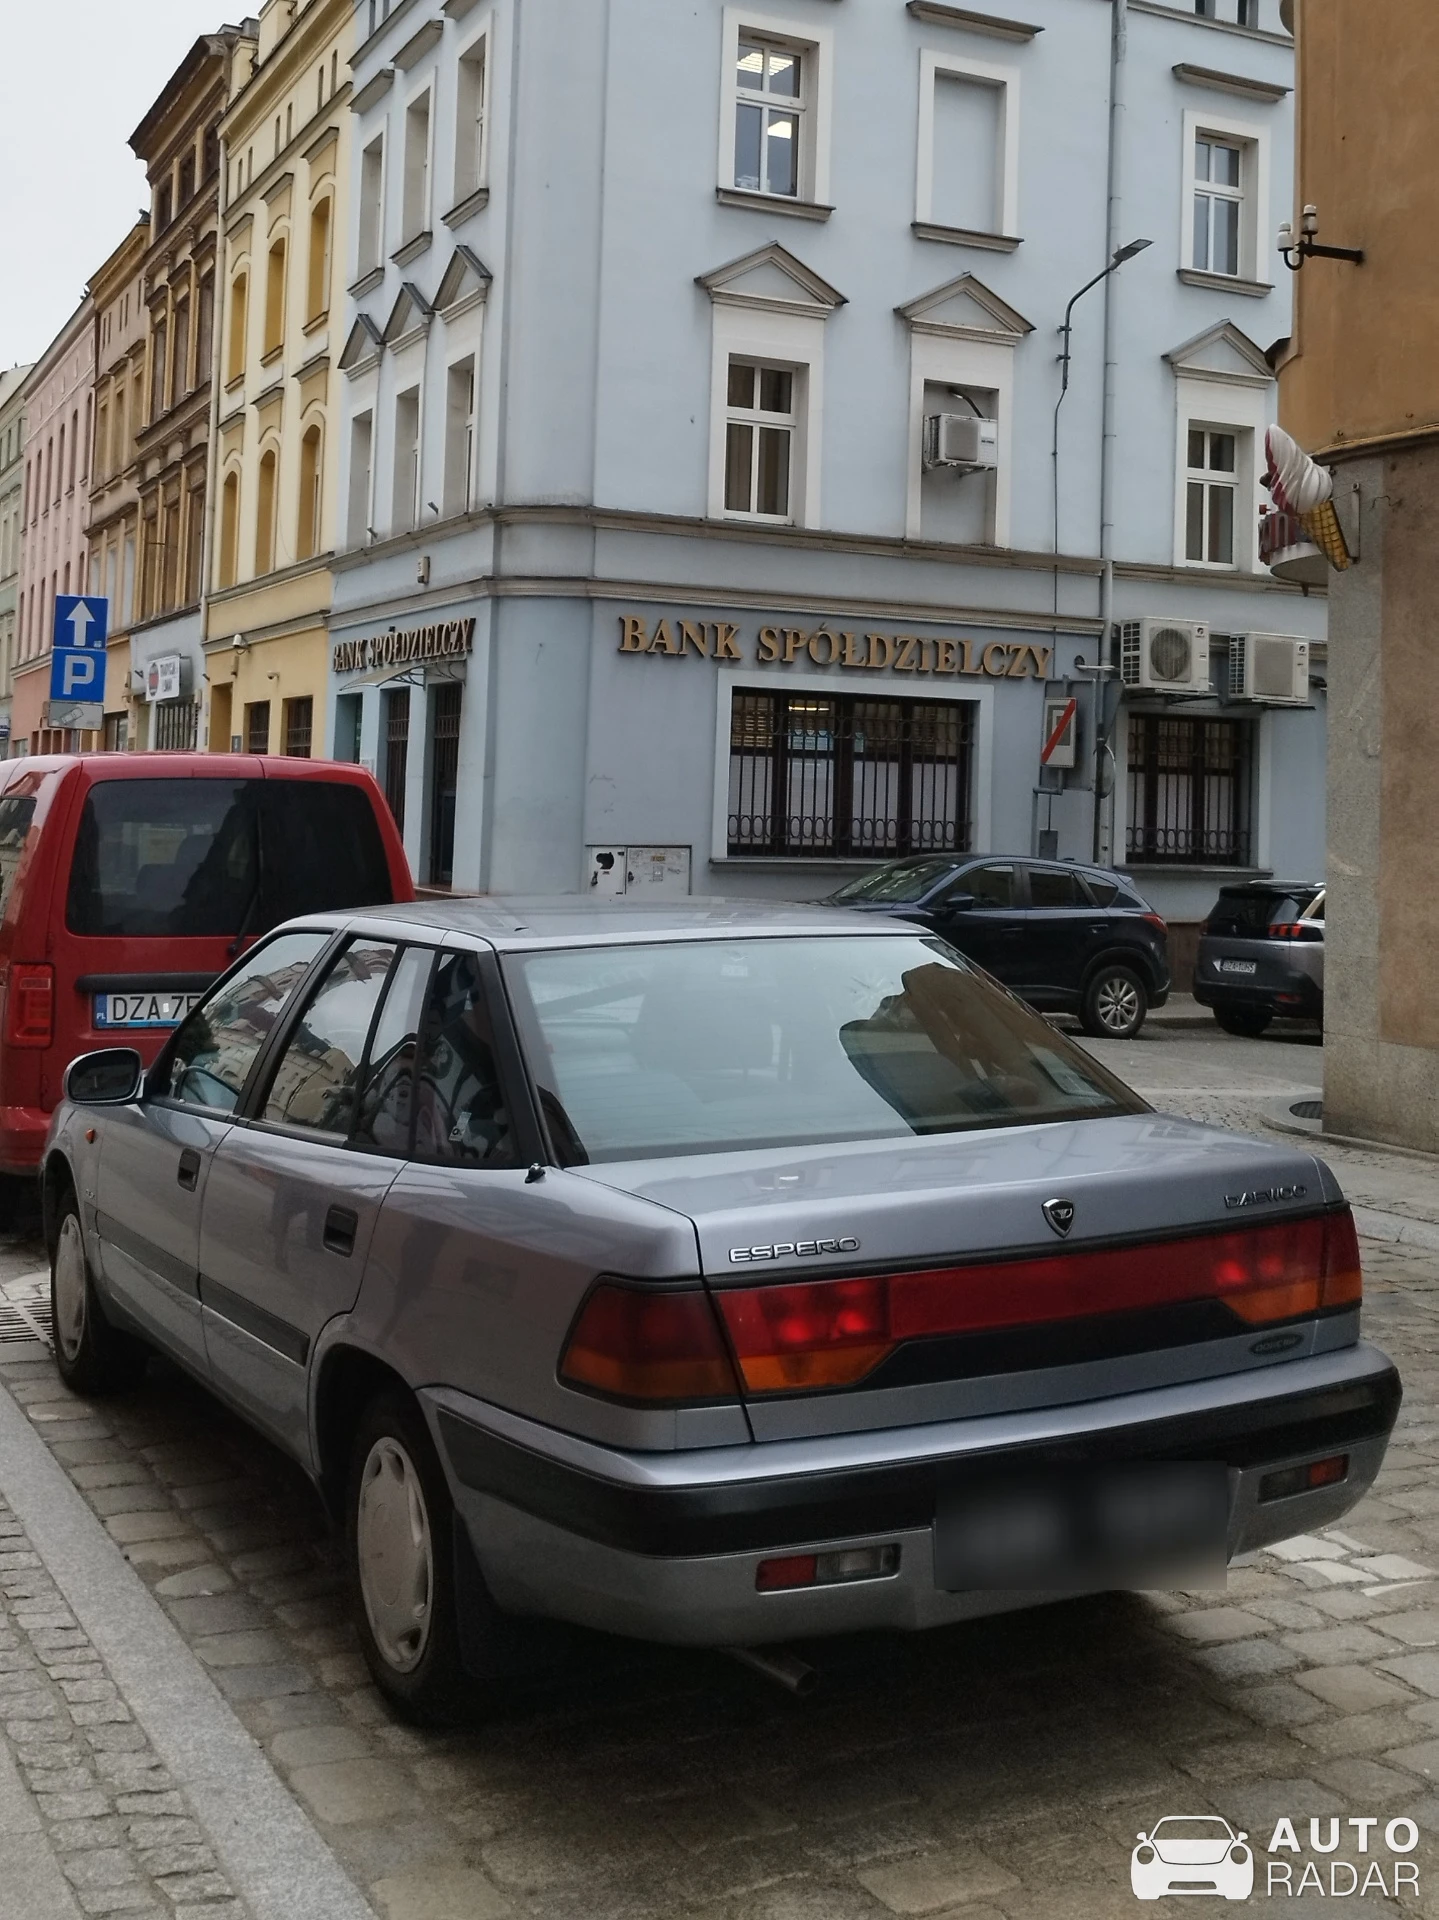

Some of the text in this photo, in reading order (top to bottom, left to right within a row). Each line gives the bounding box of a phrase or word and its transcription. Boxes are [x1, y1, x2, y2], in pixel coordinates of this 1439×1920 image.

[334, 617, 476, 672] BANK SPÓŁDZIELCZY
[618, 615, 1055, 679] BANK SPÓŁDZIELCZY
[63, 655, 94, 694] P
[96, 1012, 106, 1020] PL
[113, 996, 160, 1020] DZA
[1224, 1185, 1307, 1208] DAEWOO
[728, 1236, 861, 1263] ESPERO
